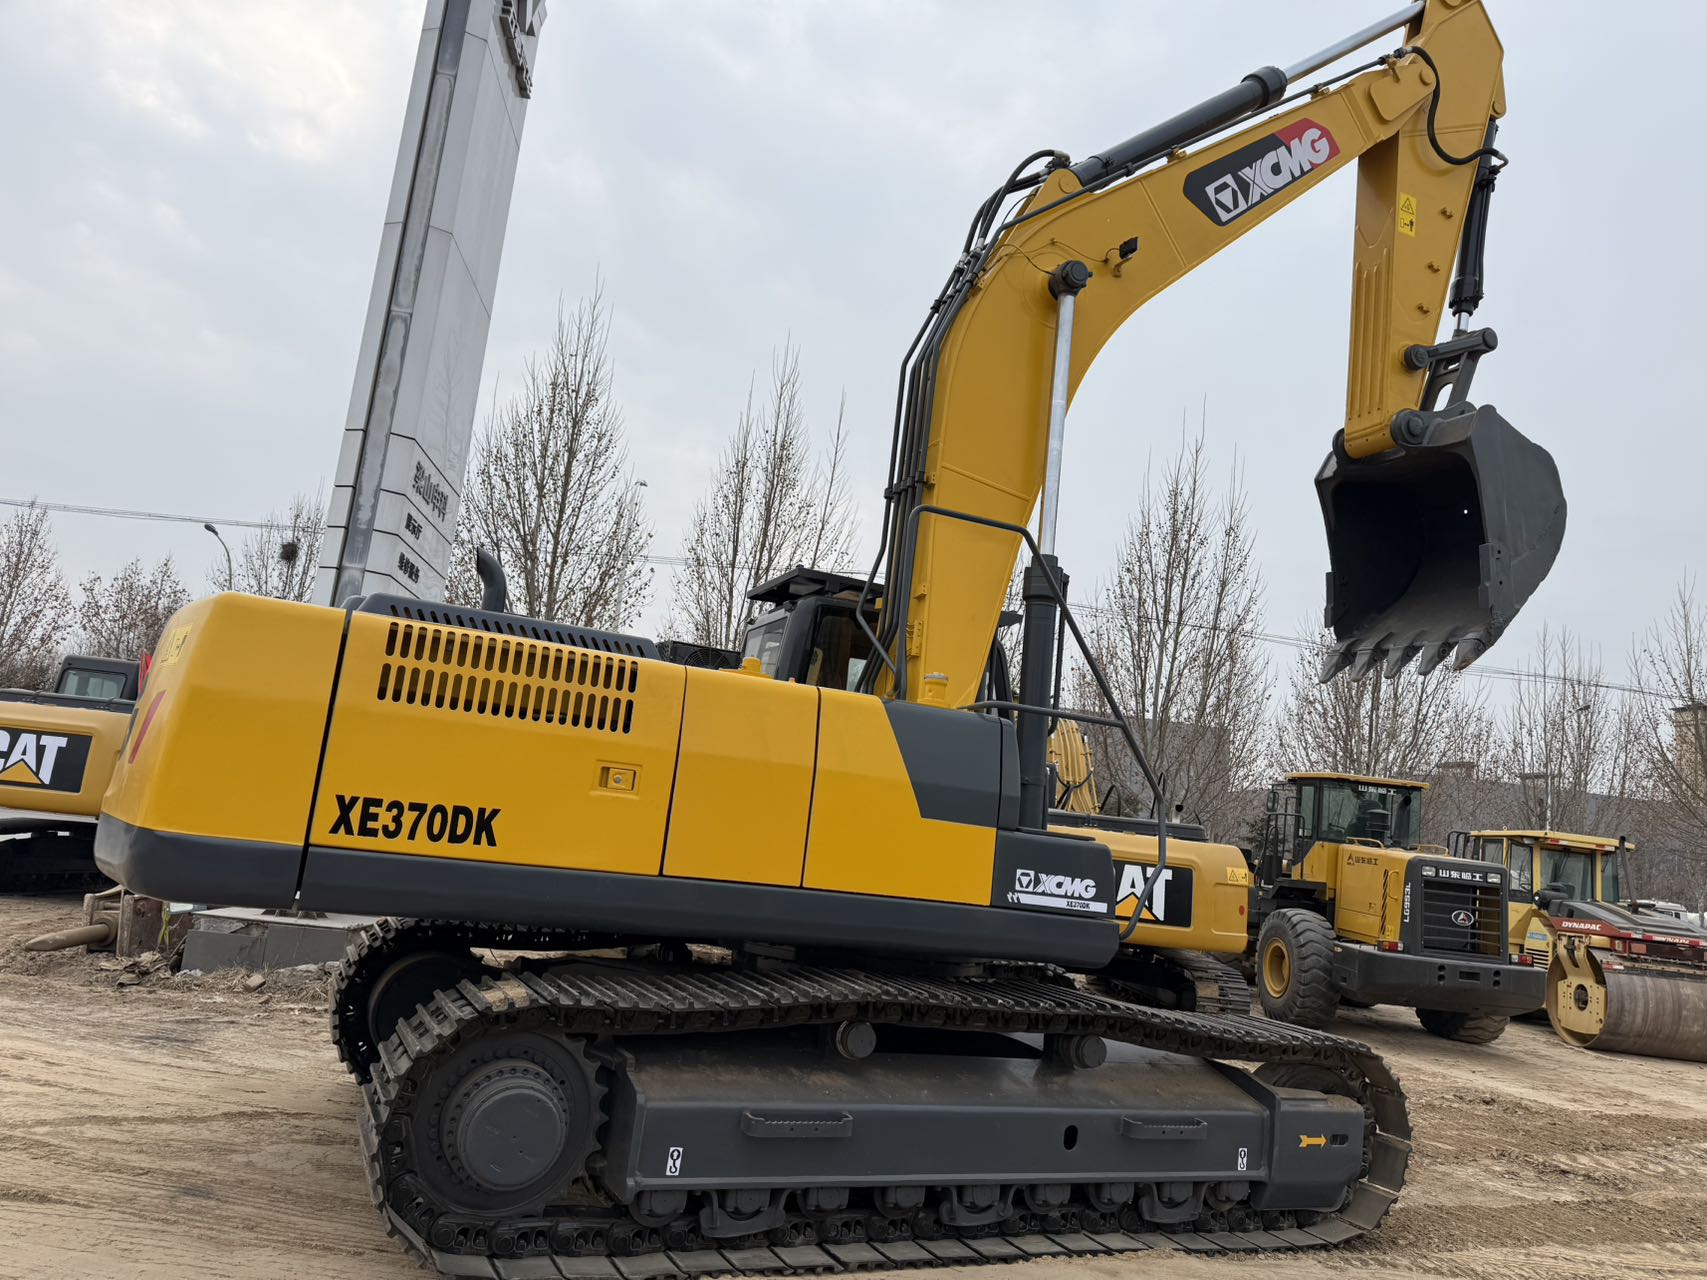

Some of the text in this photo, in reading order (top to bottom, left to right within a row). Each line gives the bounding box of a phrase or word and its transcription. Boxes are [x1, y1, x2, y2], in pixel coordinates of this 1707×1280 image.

[1238, 127, 1330, 207] XCMG
[328, 794, 501, 847] XE370DK
[1033, 873, 1097, 899] XCMG
[1439, 869, 1483, 882] 山东临工
[1066, 901, 1091, 910] XE370DK
[1114, 864, 1173, 922] AT
[1562, 921, 1601, 931] DYNAPAC
